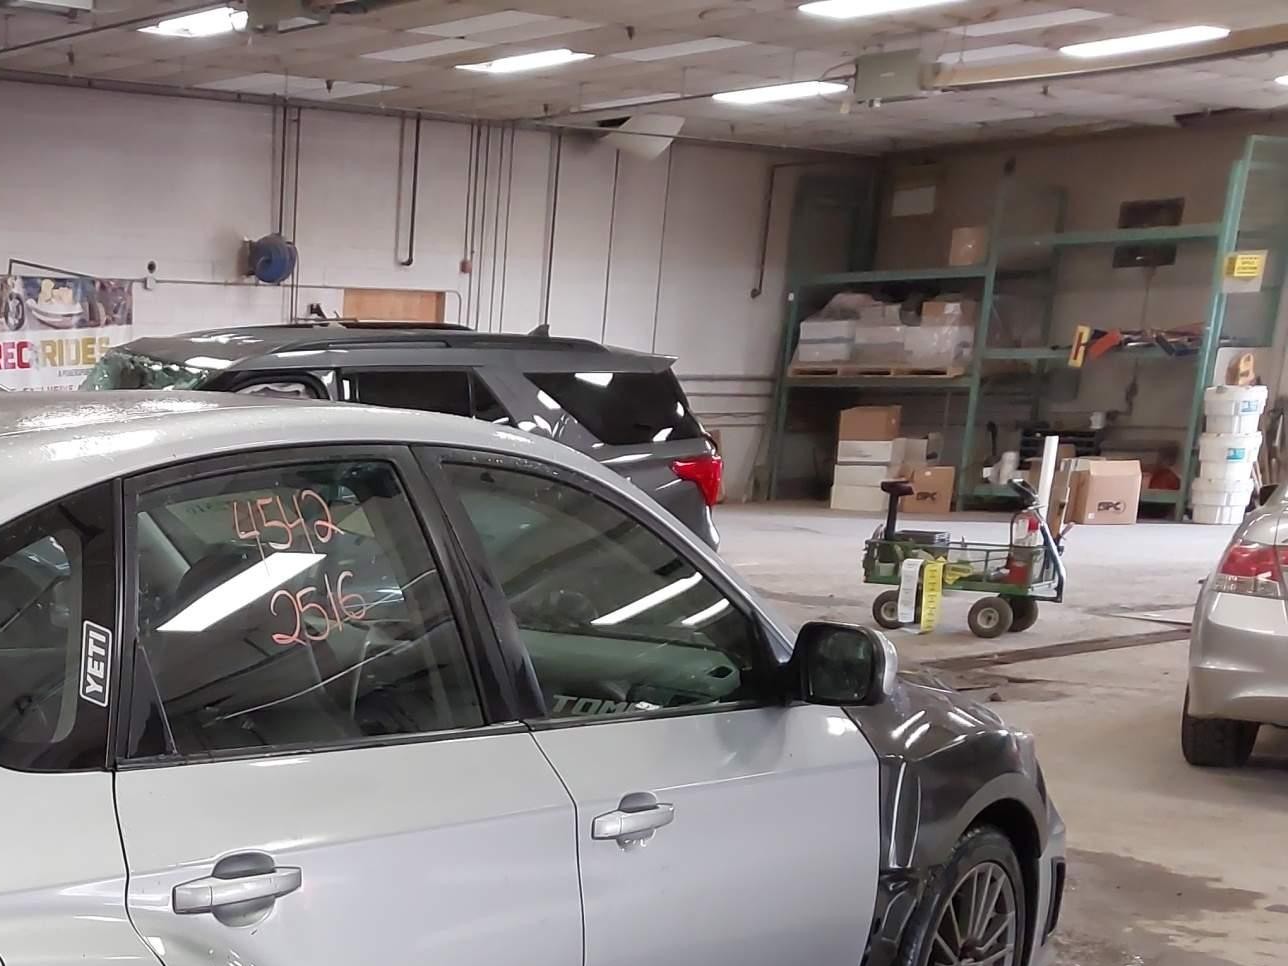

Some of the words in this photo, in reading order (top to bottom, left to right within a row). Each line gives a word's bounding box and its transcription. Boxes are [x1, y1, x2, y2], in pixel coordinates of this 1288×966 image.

[233, 489, 345, 576] 4542
[270, 571, 366, 646] 2516
[85, 630, 107, 694] YETI
